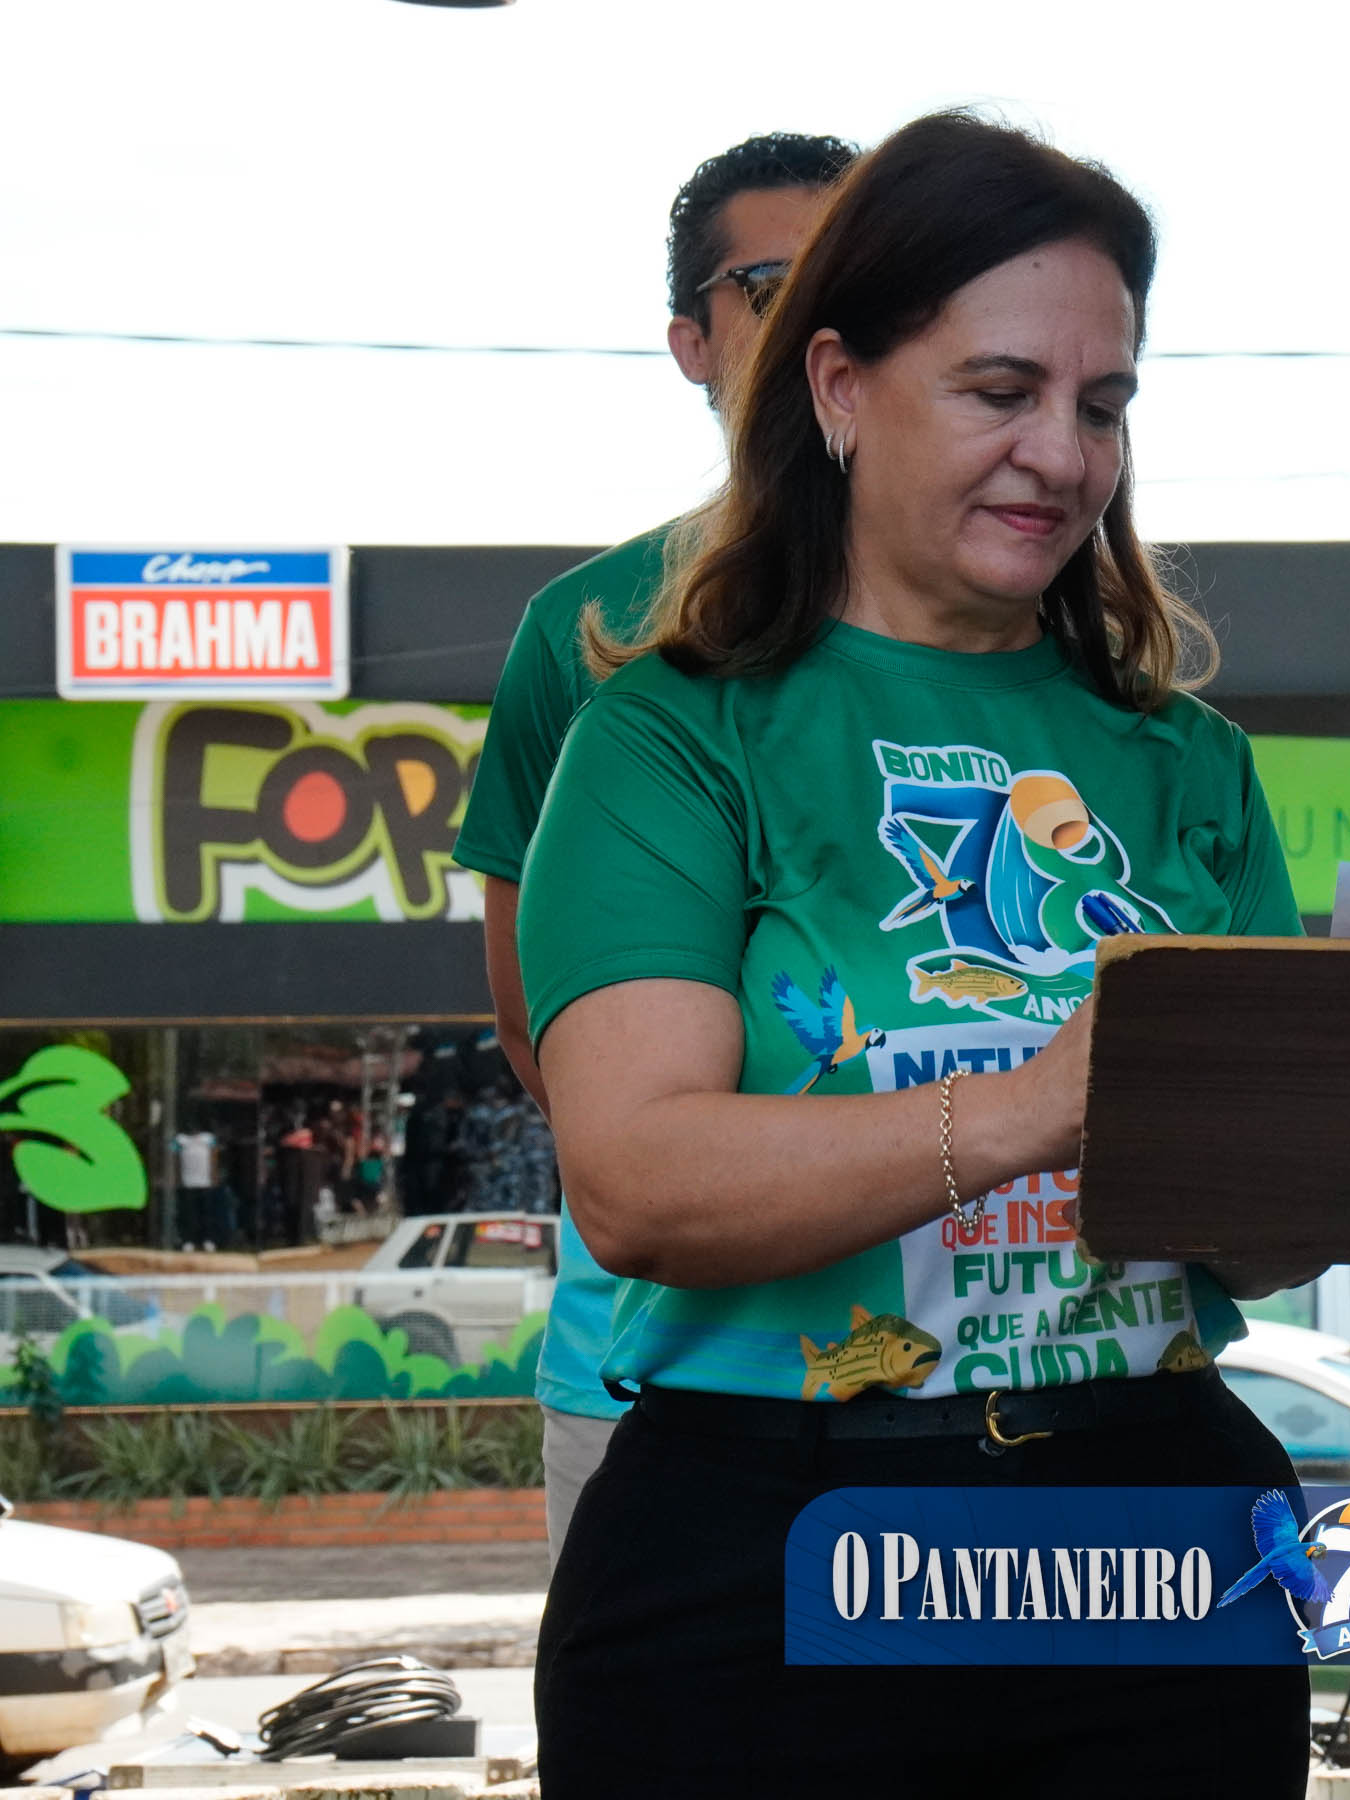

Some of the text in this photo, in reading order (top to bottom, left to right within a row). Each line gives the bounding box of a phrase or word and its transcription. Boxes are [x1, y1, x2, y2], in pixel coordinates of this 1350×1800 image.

[84, 600, 319, 670] BRAHMA
[879, 745, 1008, 787] BONITO
[162, 706, 480, 914] FOR
[957, 1277, 1185, 1352] QUE A GENTE
